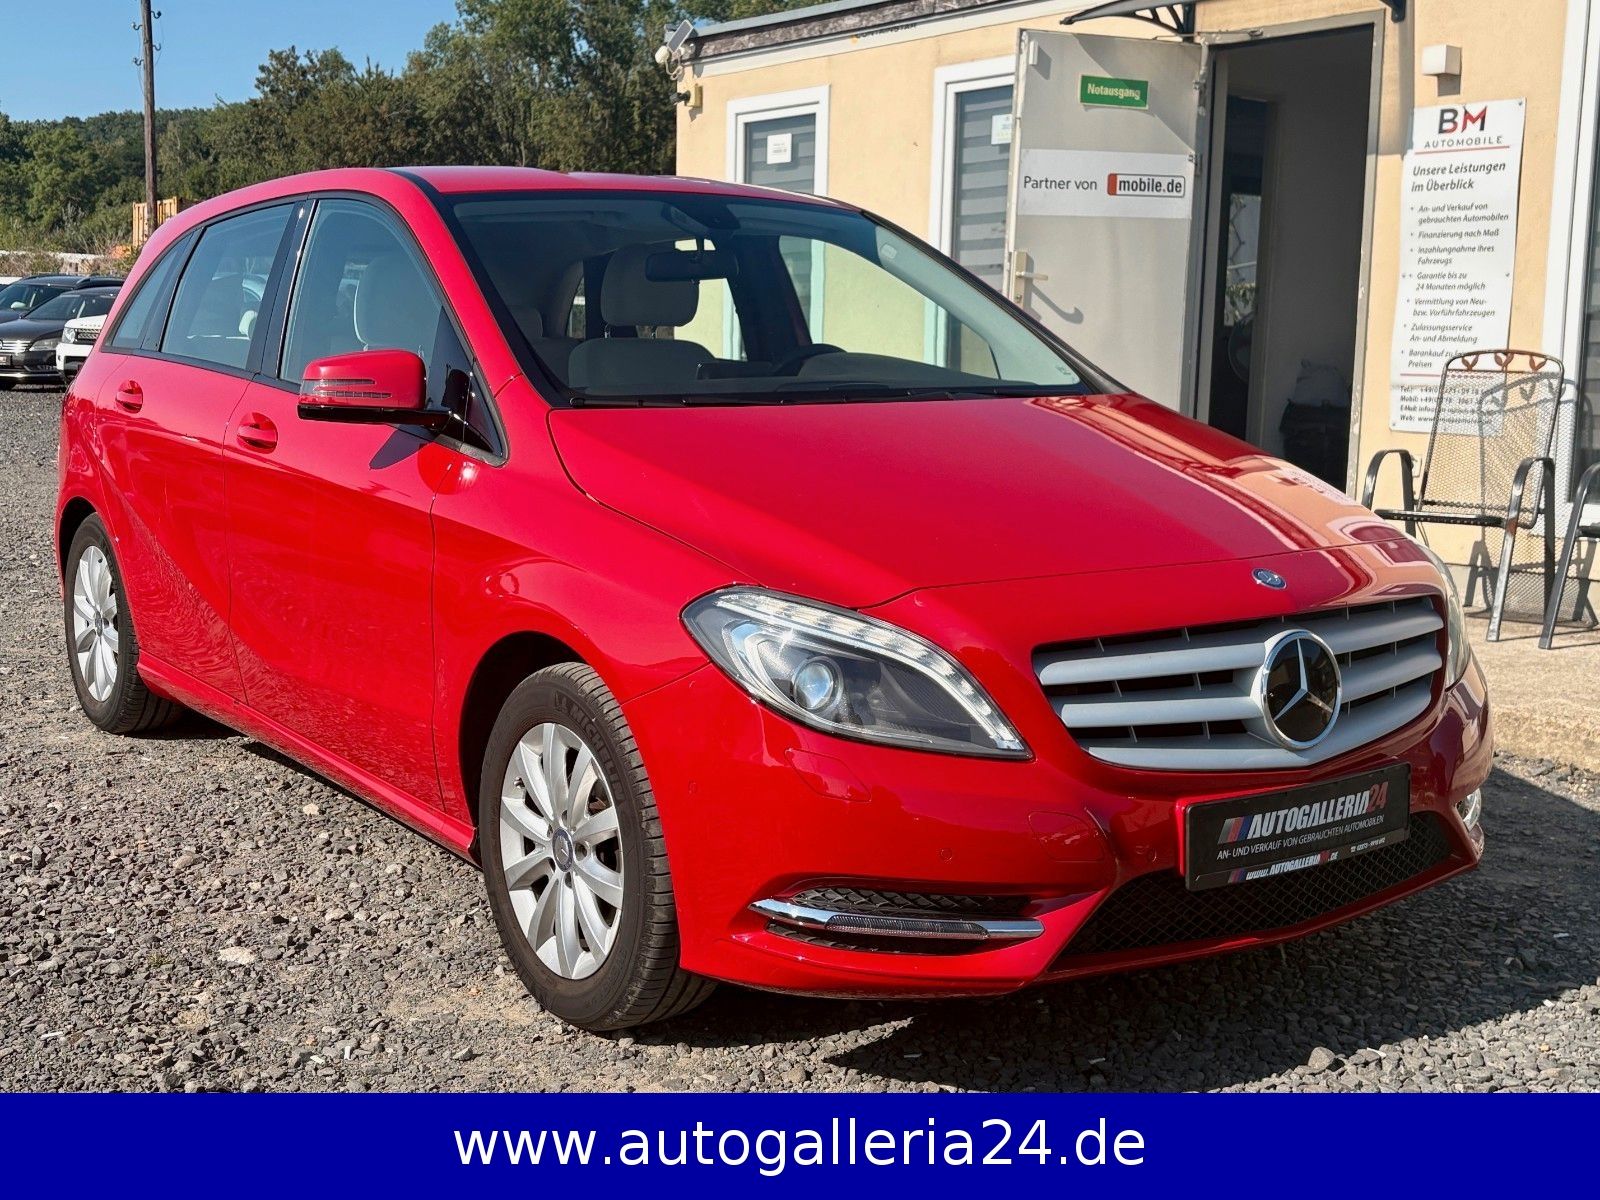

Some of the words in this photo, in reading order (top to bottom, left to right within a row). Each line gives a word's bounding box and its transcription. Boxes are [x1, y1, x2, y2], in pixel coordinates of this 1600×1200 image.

[1087, 83, 1141, 100] Notausgang
[1438, 105, 1487, 134] BM
[1424, 135, 1503, 149] AUTOMOBILE
[1413, 165, 1447, 176] Unsere
[1448, 162, 1506, 175] Leistungen
[1023, 175, 1071, 190] Partner
[1074, 179, 1097, 190] von
[1118, 178, 1182, 193] mobile.de
[1411, 181, 1424, 192] im
[1426, 178, 1474, 192] Überblick
[1418, 205, 1430, 213] An-
[1431, 203, 1446, 213] und
[1447, 202, 1474, 212] Verkauf
[1475, 203, 1488, 211] von
[1418, 214, 1462, 225] gebrauchten
[1463, 212, 1509, 222] Automobilen
[1418, 230, 1463, 239] Finanzierung
[1464, 229, 1481, 237] nach
[1417, 257, 1452, 266] Fahrzeugs
[1417, 271, 1446, 280] Garantie
[1447, 271, 1457, 279] bis
[1425, 282, 1456, 290] Monaten
[1457, 282, 1486, 292] möglich
[1414, 298, 1455, 306] Vermittlung
[1429, 308, 1495, 317] Vorführfahrzeugen
[1411, 323, 1473, 332] Zulassungsservice
[1437, 335, 1478, 344] Abmeldung
[1408, 348, 1445, 357] Barankauf
[1408, 359, 1432, 368] Preisen
[1247, 782, 1388, 839] AUTOGALLERIA24
[1217, 849, 1231, 860] AN-
[1232, 845, 1250, 857] UND
[1250, 839, 1282, 853] VERKAUF
[1283, 836, 1299, 848] VON
[1299, 825, 1344, 844] GEBRAUCHTEN
[1344, 814, 1385, 833] AUTOMOBILEN
